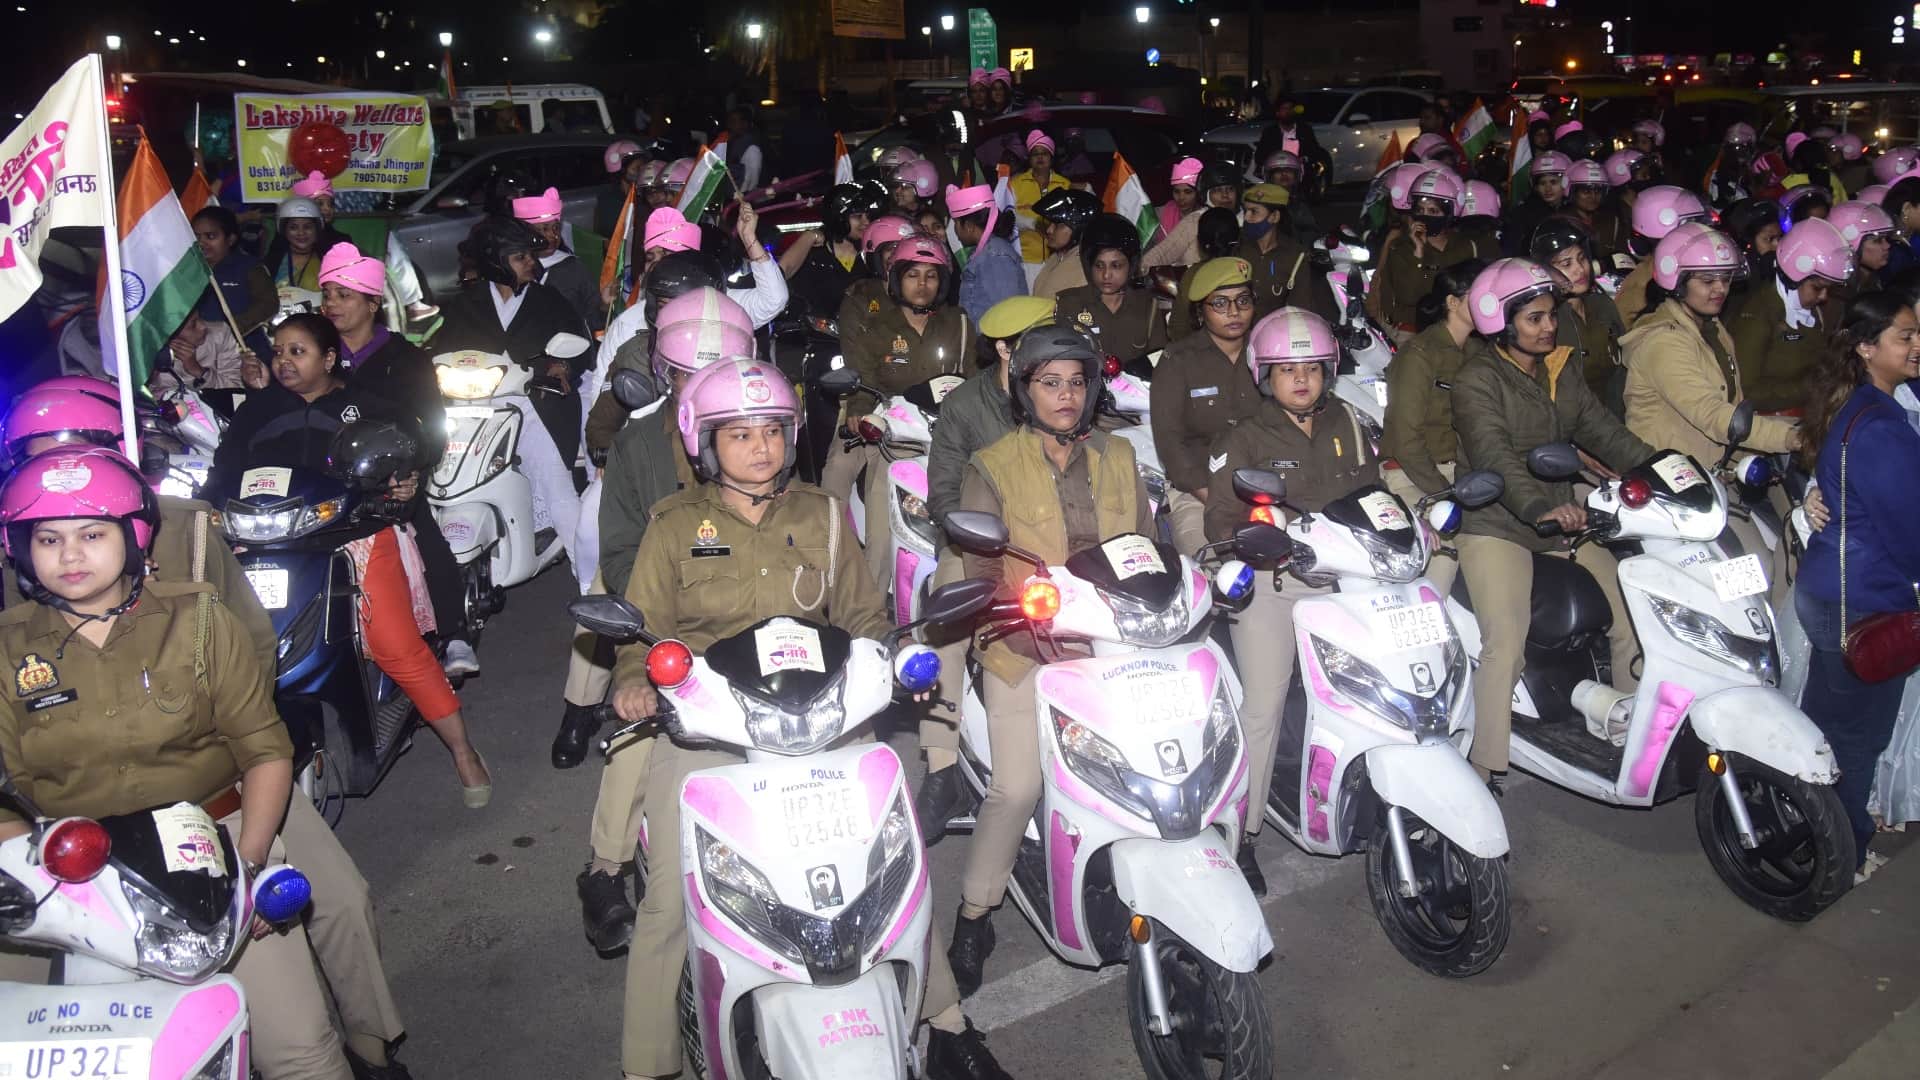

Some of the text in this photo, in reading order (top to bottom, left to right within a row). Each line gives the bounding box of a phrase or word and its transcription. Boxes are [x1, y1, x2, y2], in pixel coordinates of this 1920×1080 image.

[353, 103, 425, 126] Welfare
[1389, 605, 1437, 630] UP32E
[1102, 659, 1181, 681] LUCKNOW POLICE
[781, 781, 825, 793] HONDA
[49, 1024, 113, 1034] HONDA
[818, 1023, 885, 1049] PATROL
[26, 1044, 134, 1080] UP32E
